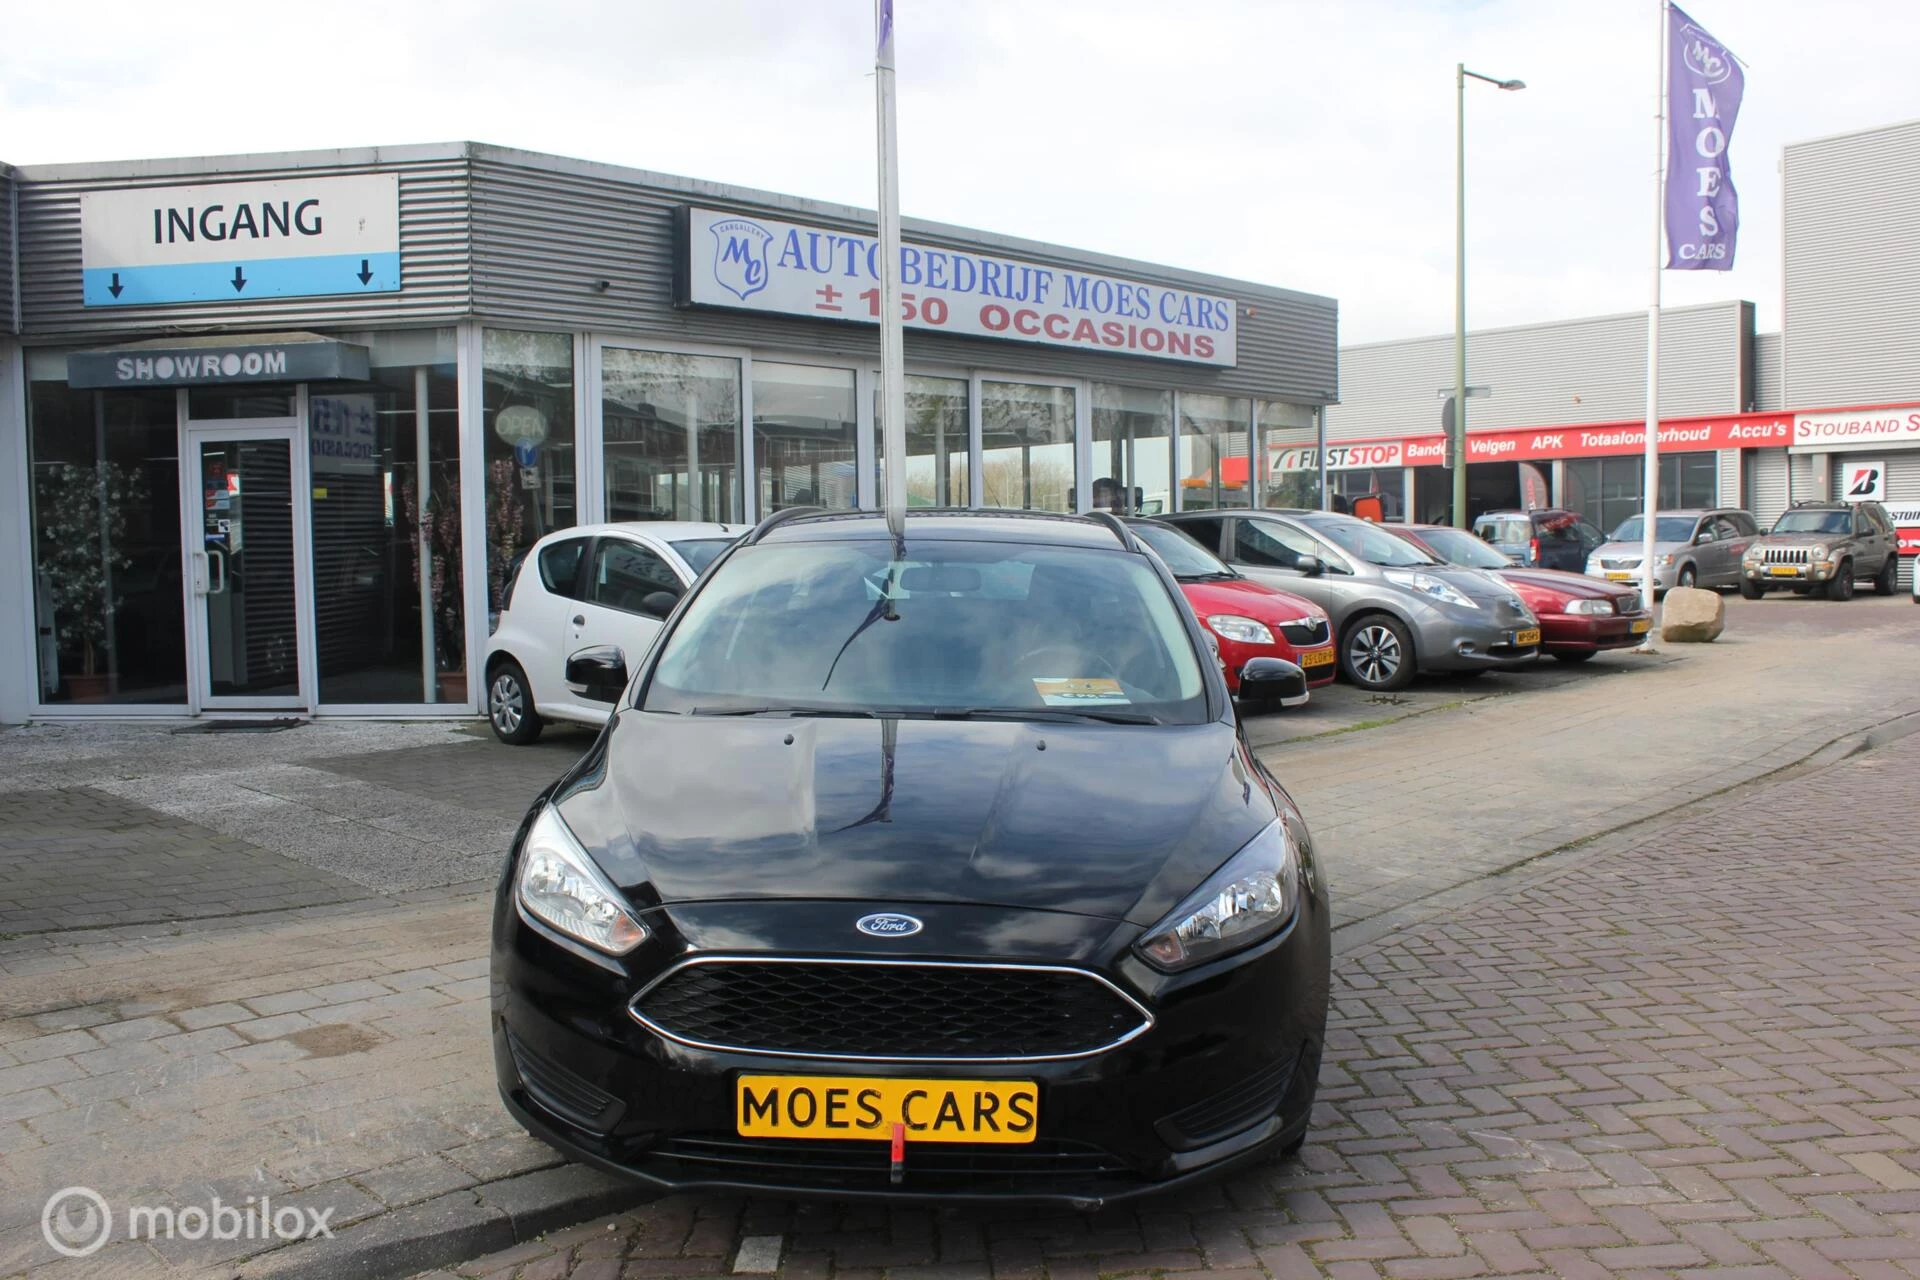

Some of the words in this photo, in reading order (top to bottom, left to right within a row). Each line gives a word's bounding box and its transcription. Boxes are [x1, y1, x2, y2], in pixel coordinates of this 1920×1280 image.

[1692, 88, 1726, 237] MOES
[153, 199, 323, 244] INGANG
[1062, 274, 1151, 320] MOES
[1159, 291, 1229, 332] CARS
[979, 304, 1215, 358] OCCASIONS
[117, 350, 287, 380] SHOWROOM
[496, 415, 546, 435] OPEN
[1470, 439, 1516, 456] Velgen
[1531, 434, 1564, 450] APK
[1581, 425, 1712, 447] Totaalonerhoud
[1728, 421, 1787, 439] Accu's
[871, 917, 907, 931] Ford
[742, 1086, 883, 1130] MOES
[901, 1090, 1035, 1133] CARS
